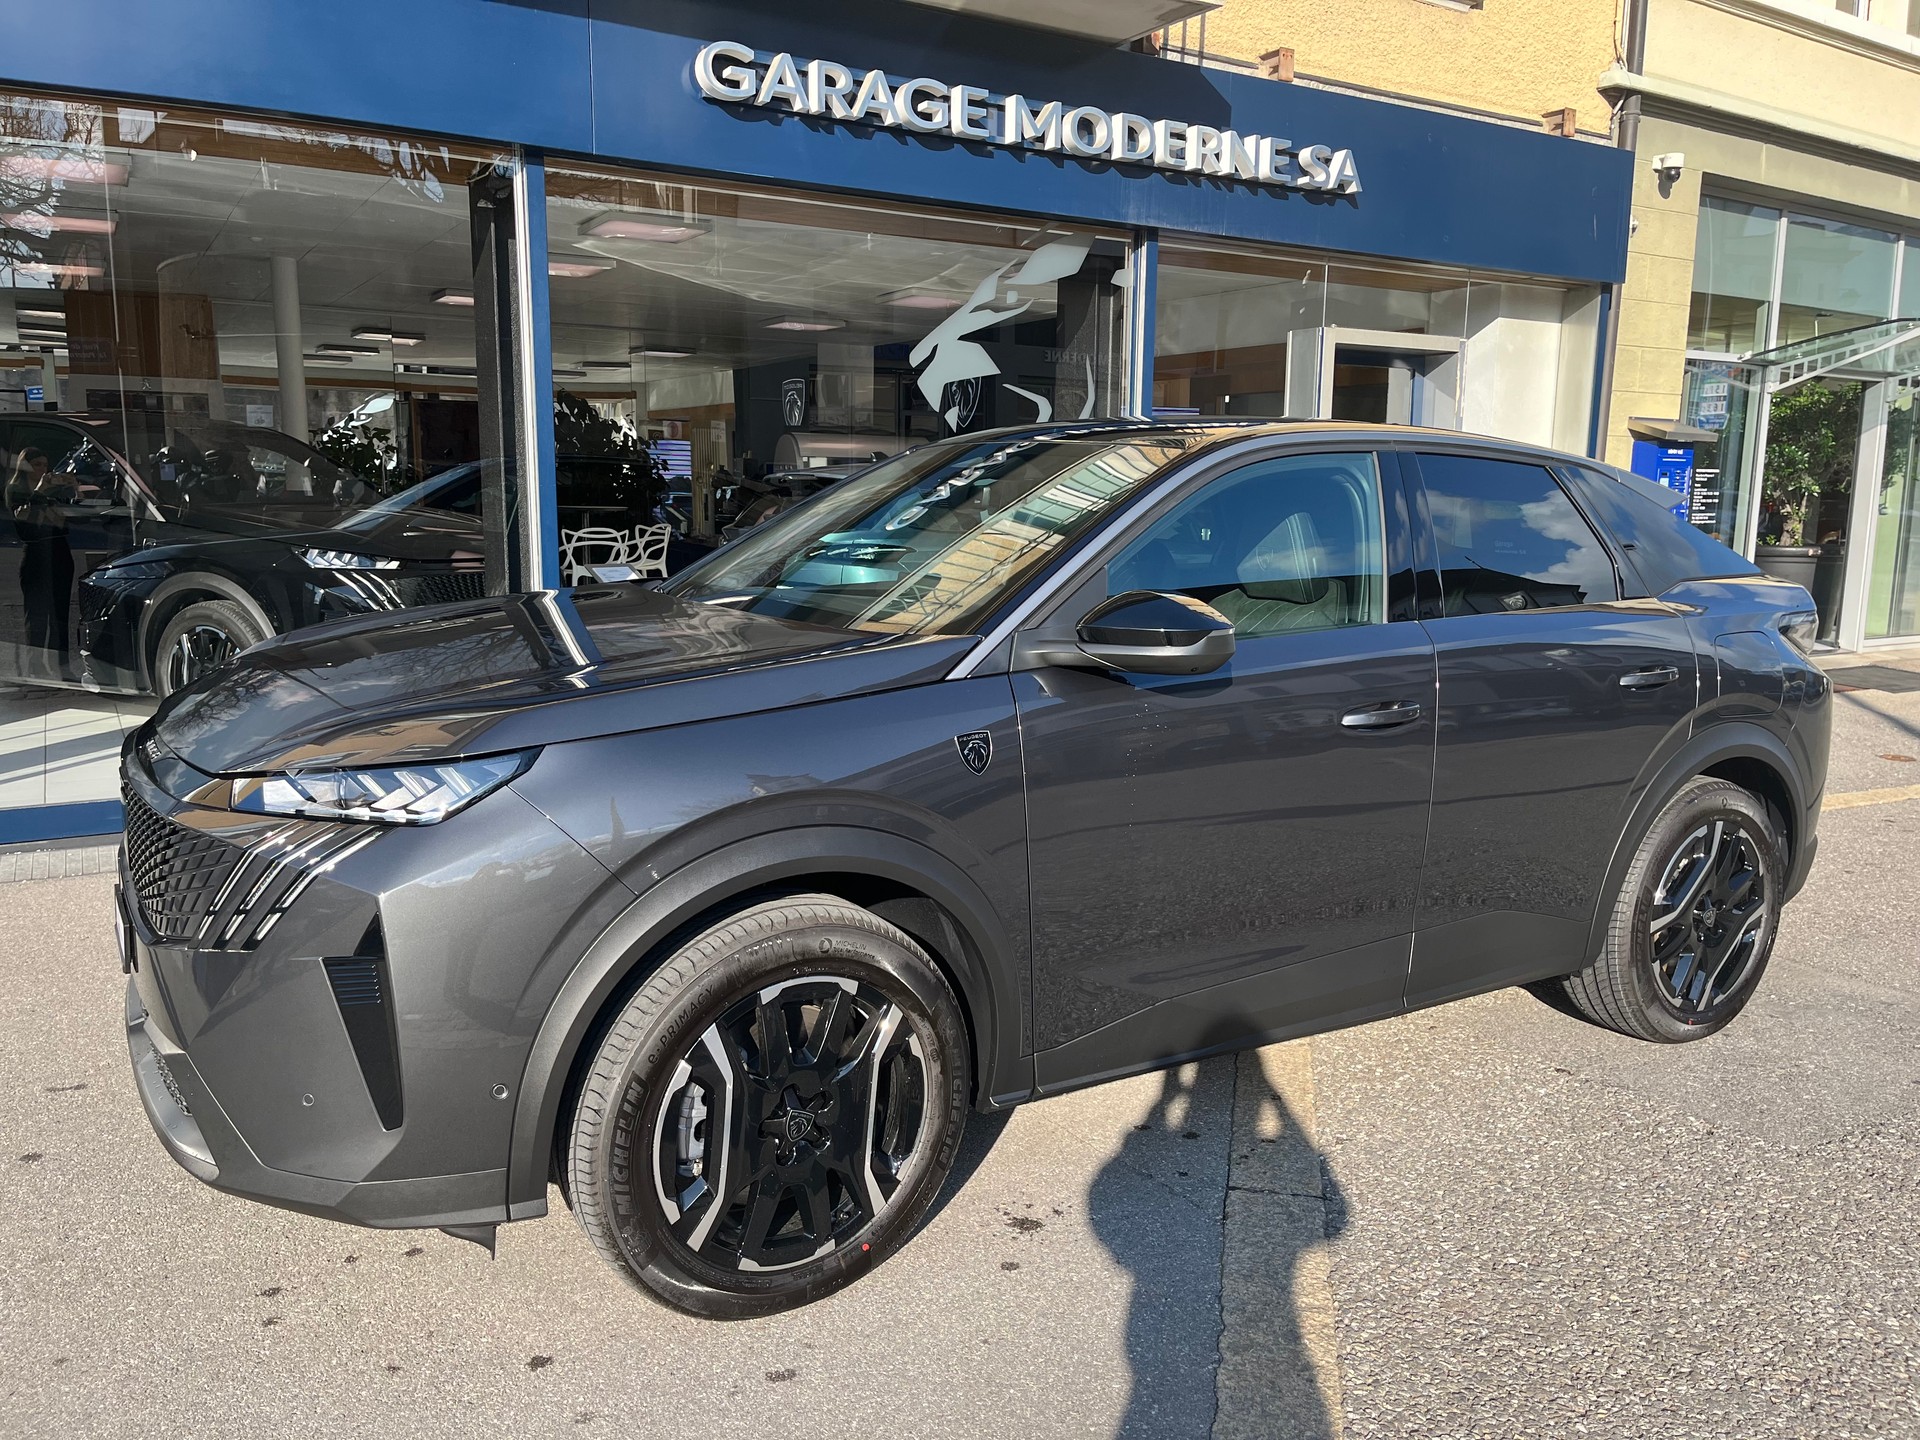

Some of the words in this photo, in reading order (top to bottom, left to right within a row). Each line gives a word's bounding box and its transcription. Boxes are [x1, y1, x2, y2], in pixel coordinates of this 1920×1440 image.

[694, 41, 992, 138] GARAGE
[1004, 93, 1292, 183] MODERNE
[1297, 144, 1363, 194] SA
[958, 733, 987, 742] PEUGEOT
[612, 1080, 645, 1217] MICHELIN
